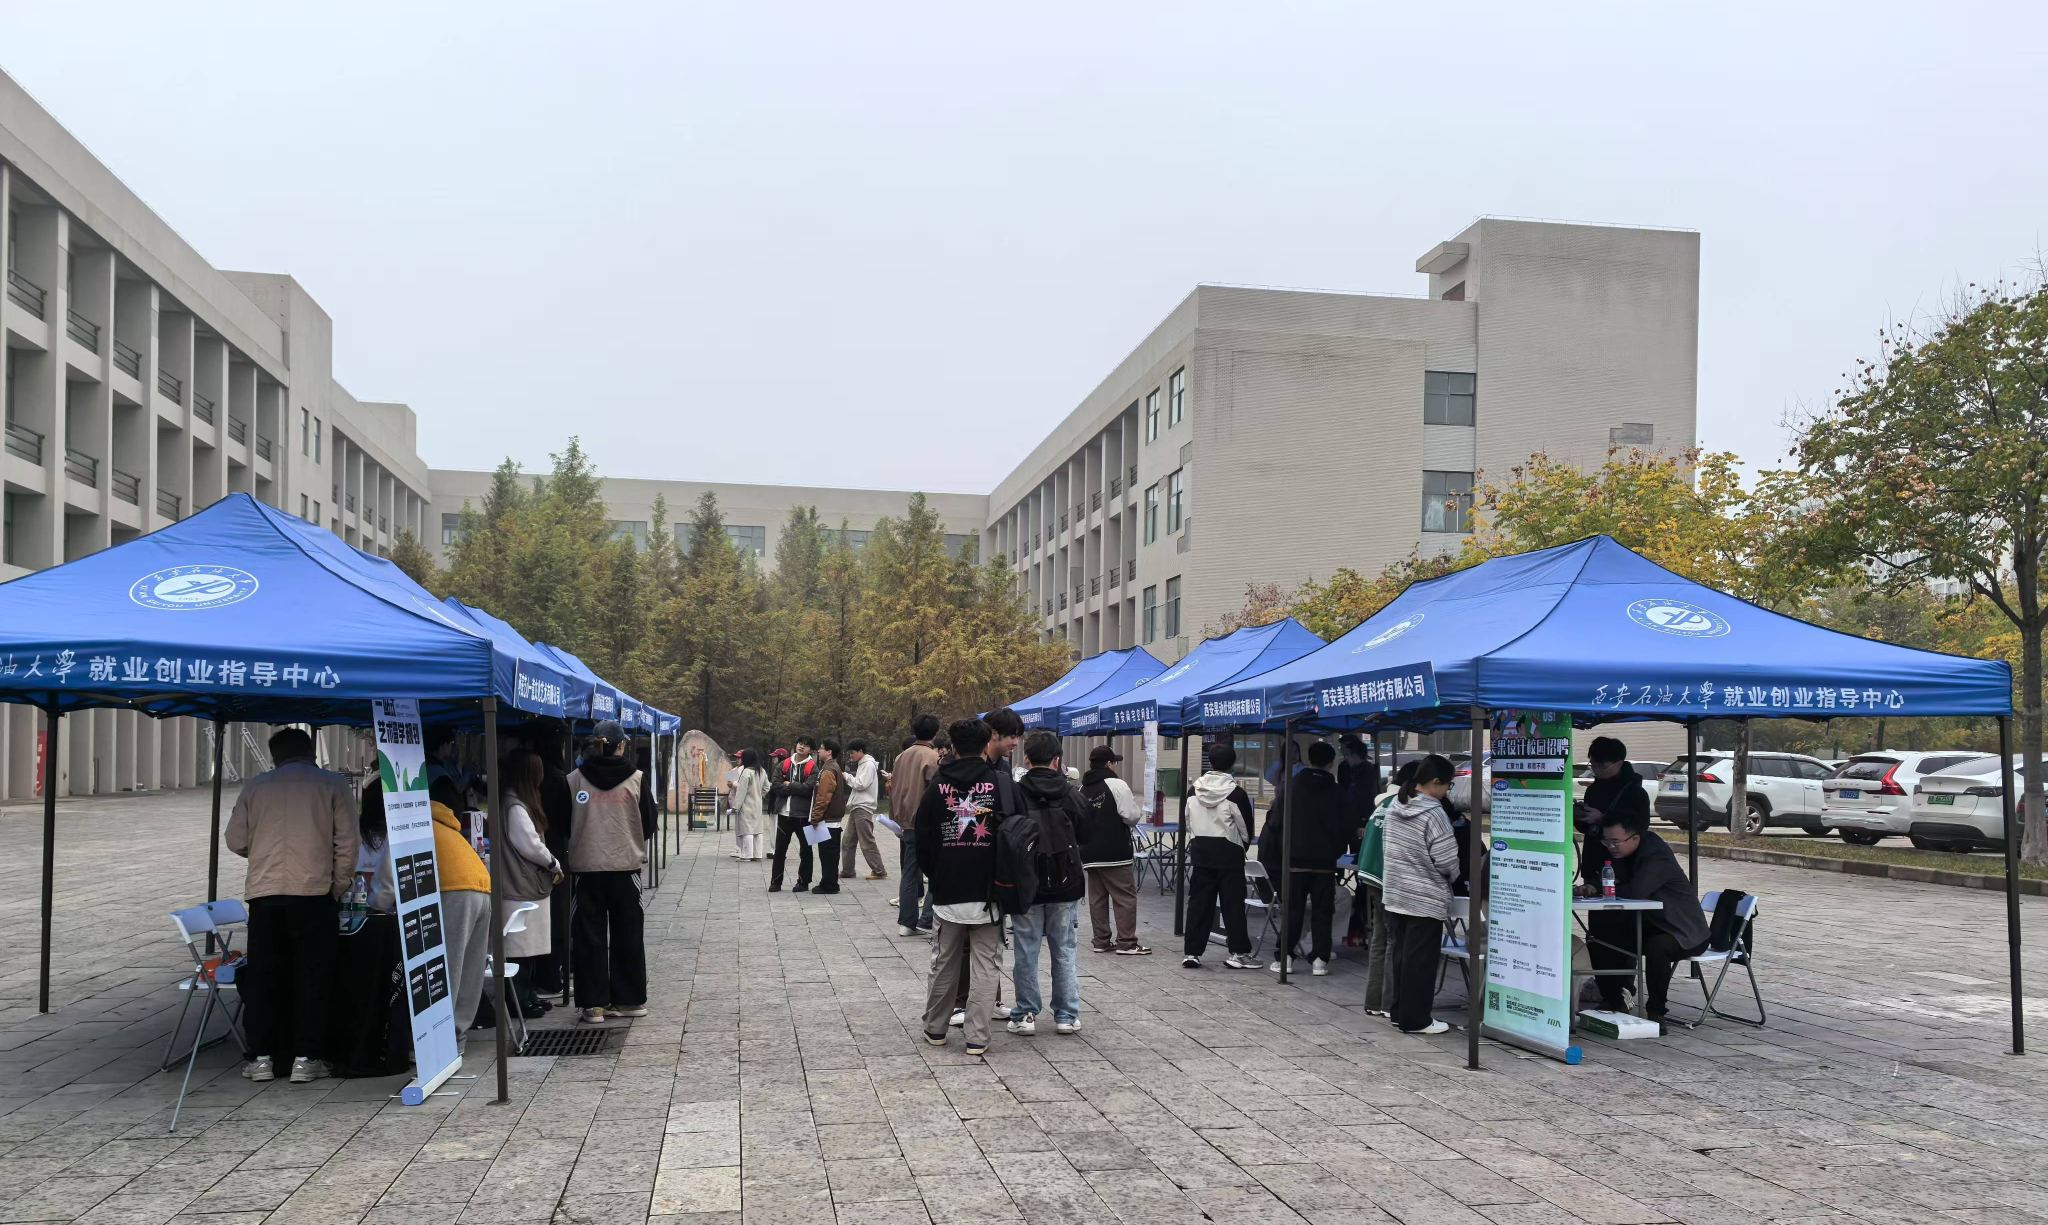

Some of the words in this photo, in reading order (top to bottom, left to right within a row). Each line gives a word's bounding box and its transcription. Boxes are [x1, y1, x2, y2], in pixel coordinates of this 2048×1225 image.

[88, 655, 341, 689] 就业创业指导中心
[1321, 674, 1426, 708] 西安美果教育科技有限公司
[1723, 686, 1905, 709] 就业创业指导中心
[1490, 737, 1570, 756] 美果设计校园招聘
